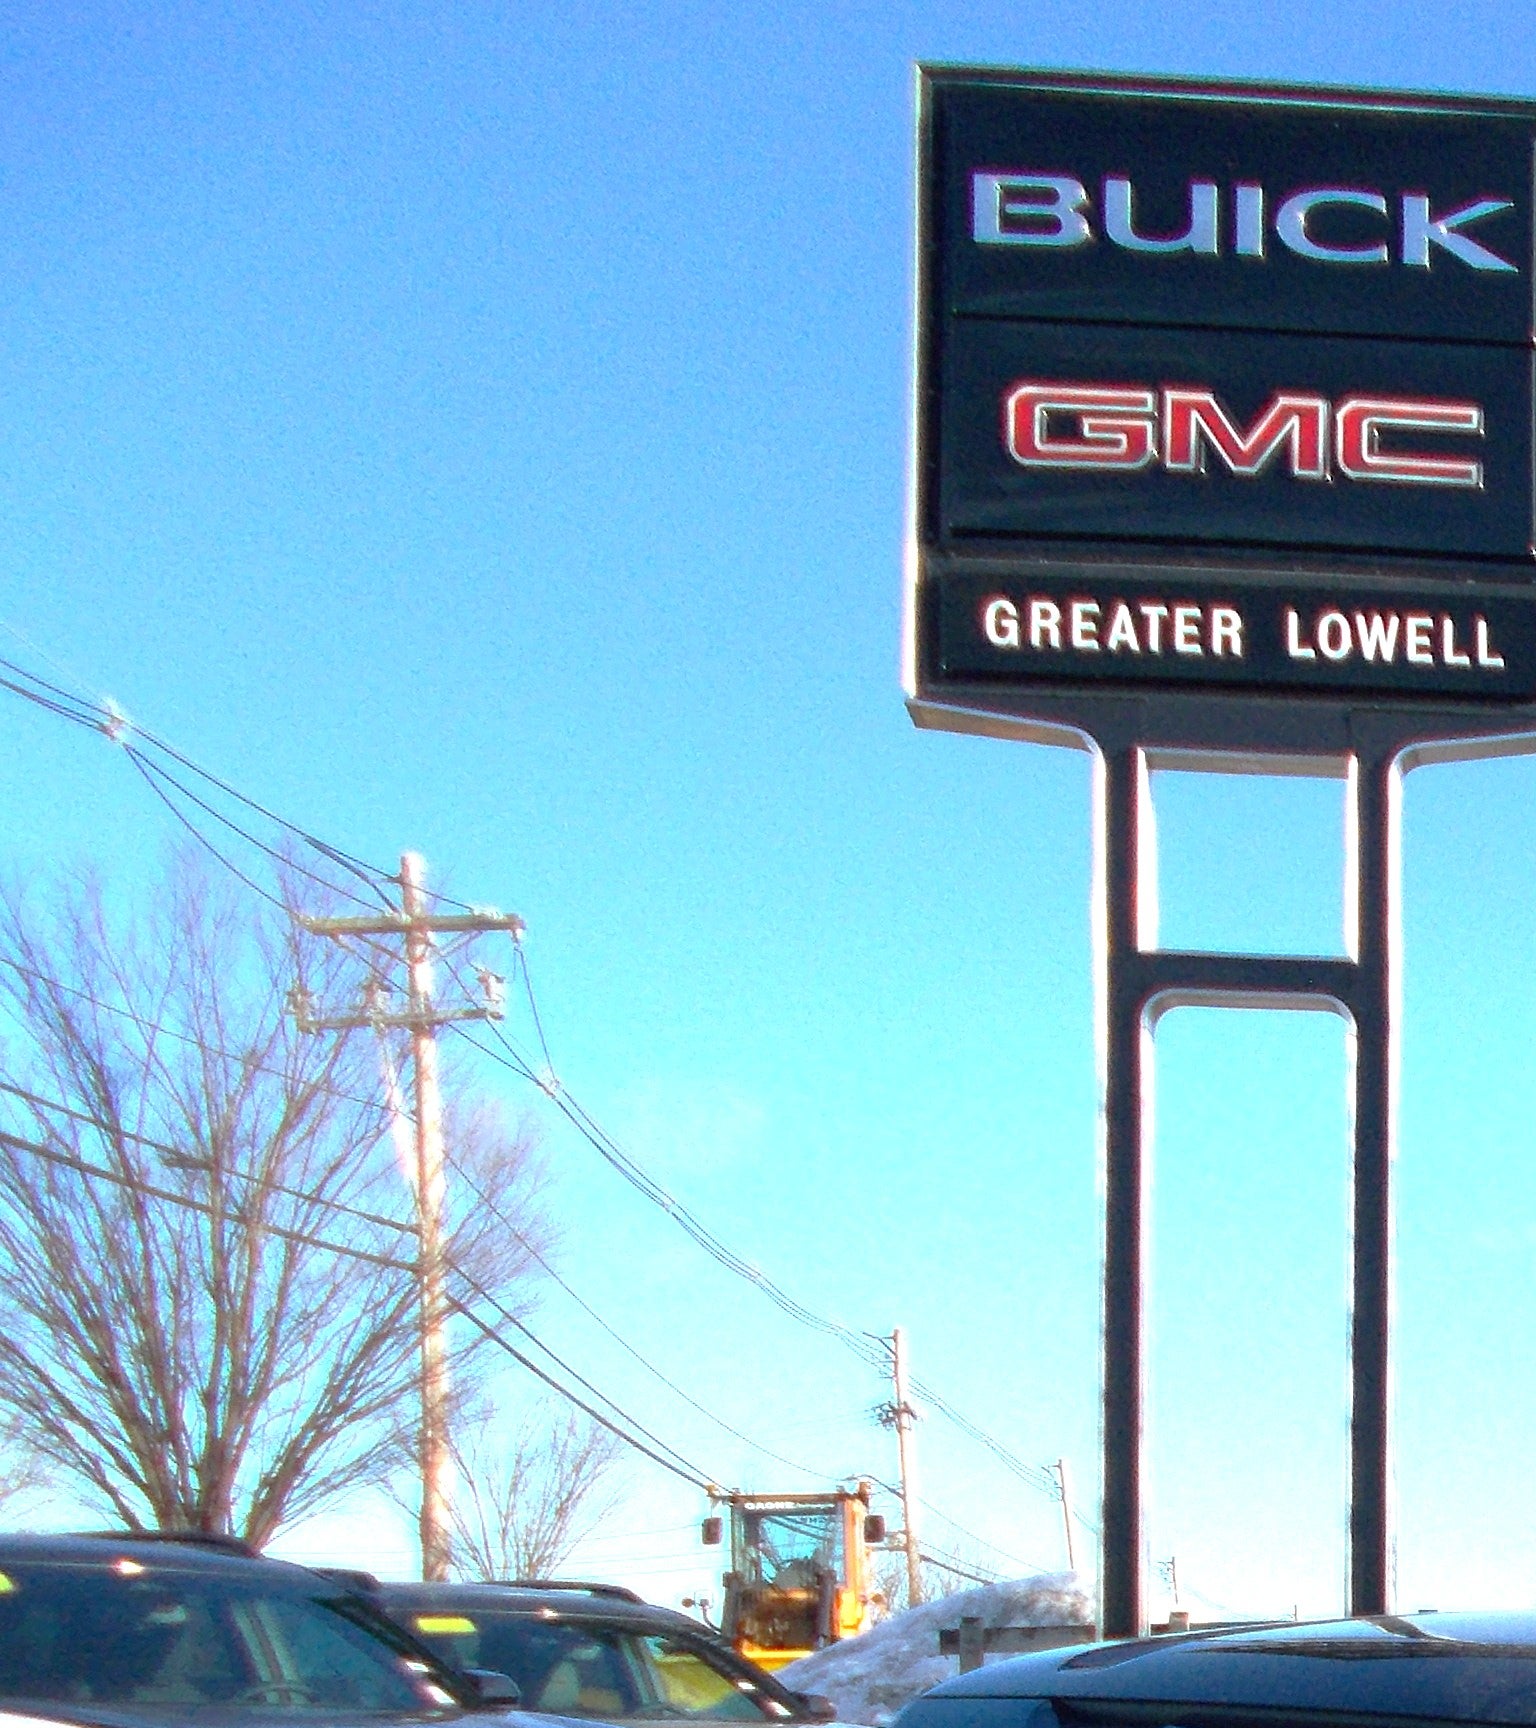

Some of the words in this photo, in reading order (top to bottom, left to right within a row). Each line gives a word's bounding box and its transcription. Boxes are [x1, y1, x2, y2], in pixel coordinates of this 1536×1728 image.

[970, 173, 1520, 273] BUICK
[1005, 384, 1486, 489] GMC
[984, 599, 1243, 657] GREATER
[1286, 609, 1506, 668] LOWELL
